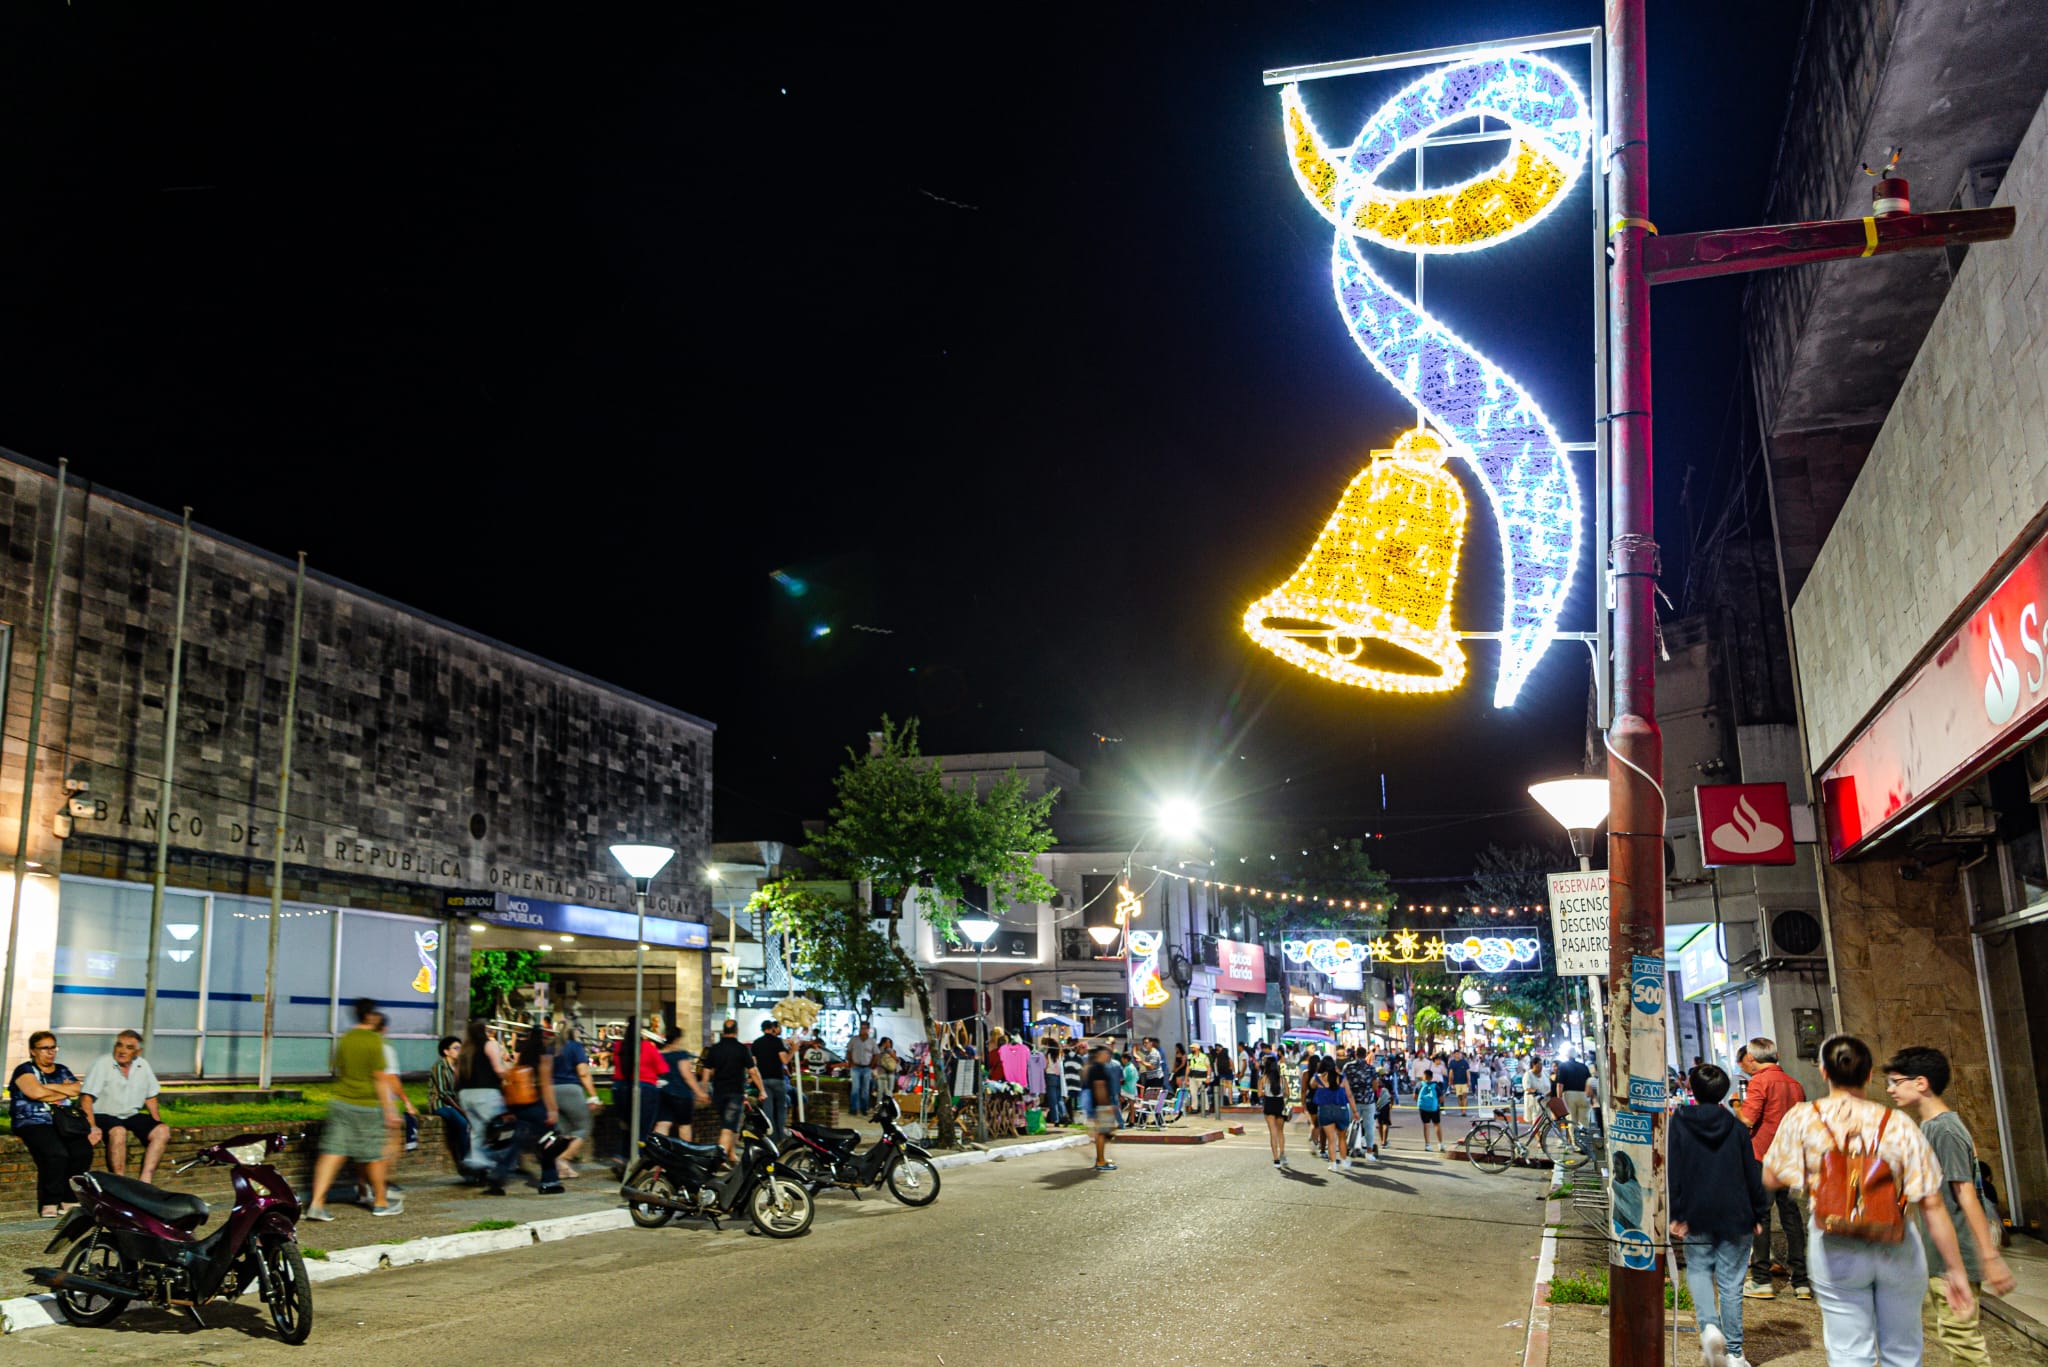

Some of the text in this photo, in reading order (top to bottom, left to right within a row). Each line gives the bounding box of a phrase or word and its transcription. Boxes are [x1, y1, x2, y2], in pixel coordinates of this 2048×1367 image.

[2020, 602, 2048, 693] S
[94, 799, 692, 916] BANCO DE A REPUBLICA ORIENTAL DEL UUGUAY
[1553, 877, 1609, 894] RESERVAD
[505, 899, 530, 914] ANCO
[1634, 984, 1664, 1005] 500
[809, 1051, 822, 1061] 20
